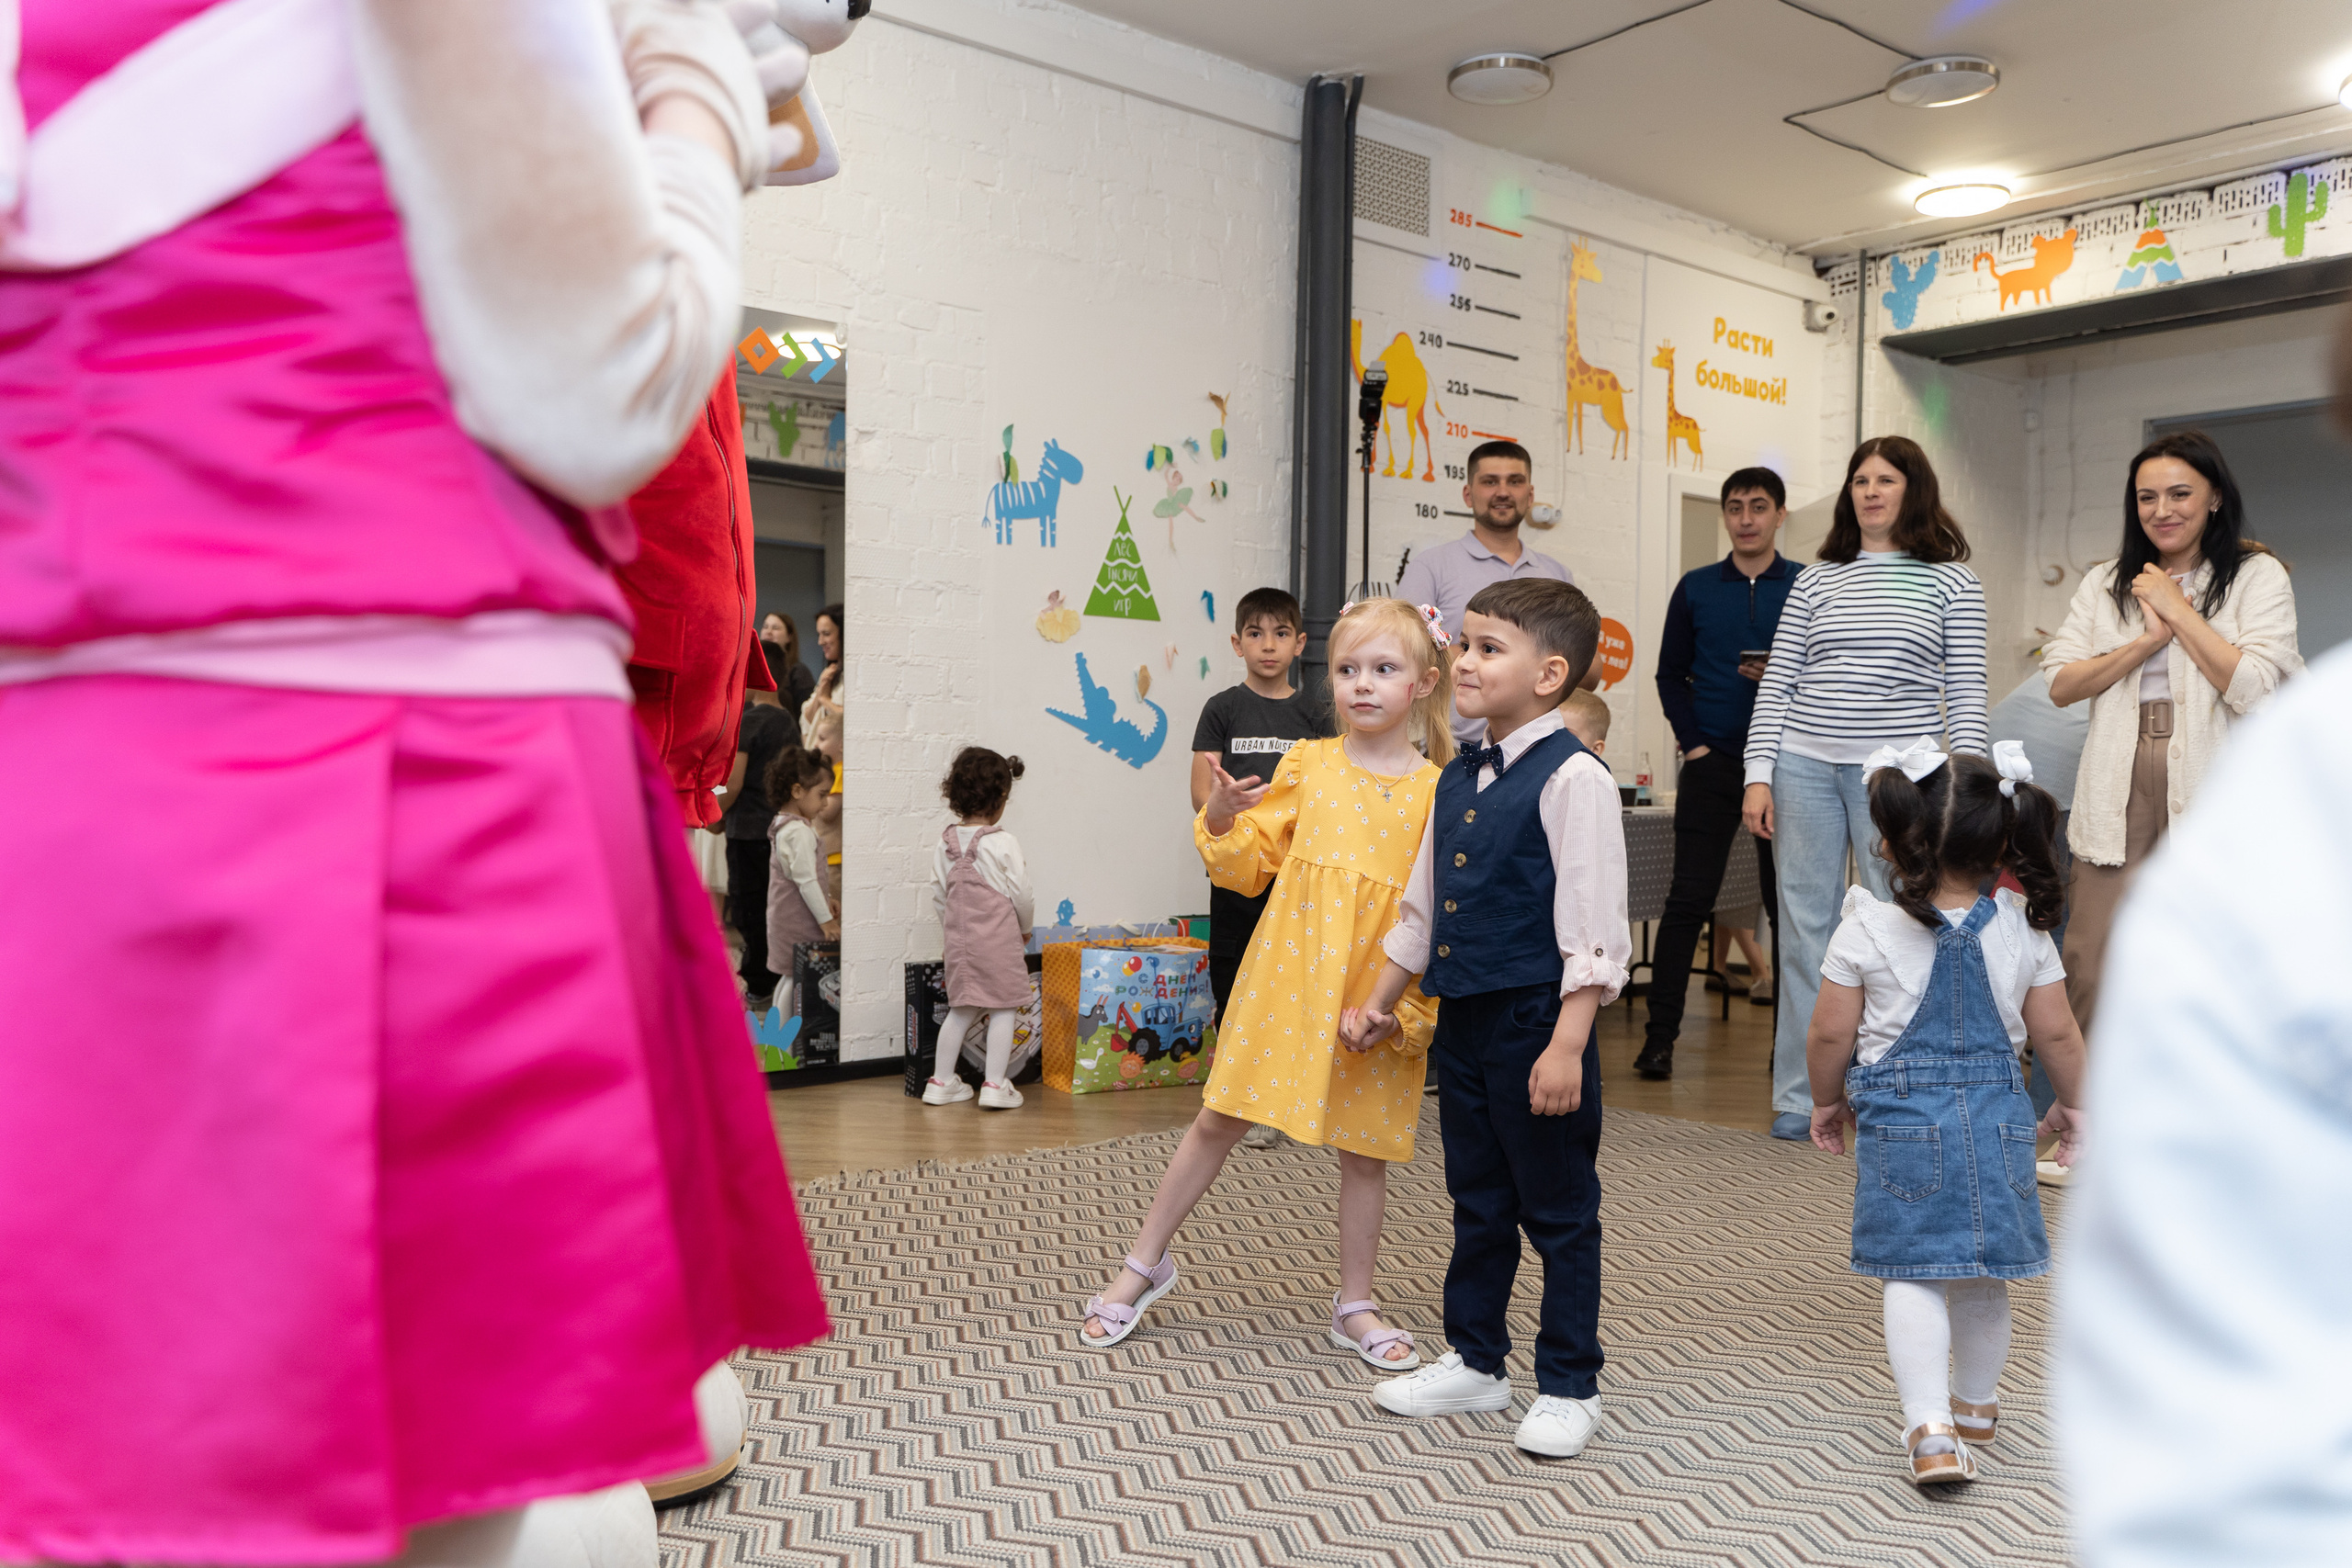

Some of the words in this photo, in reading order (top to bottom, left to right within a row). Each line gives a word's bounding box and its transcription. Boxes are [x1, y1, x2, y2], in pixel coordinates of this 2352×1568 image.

[1450, 209, 1473, 228] 285
[1448, 253, 1471, 271] 270
[1450, 293, 1472, 311] 255
[1419, 331, 1443, 349] 240
[1713, 316, 1774, 358] Расти
[1446, 379, 1469, 396] 225
[1695, 359, 1787, 406] большой!
[1446, 422, 1468, 439] 210
[1444, 465, 1465, 480] 195
[1415, 503, 1438, 519] 180
[1234, 739, 1265, 751] URBAN
